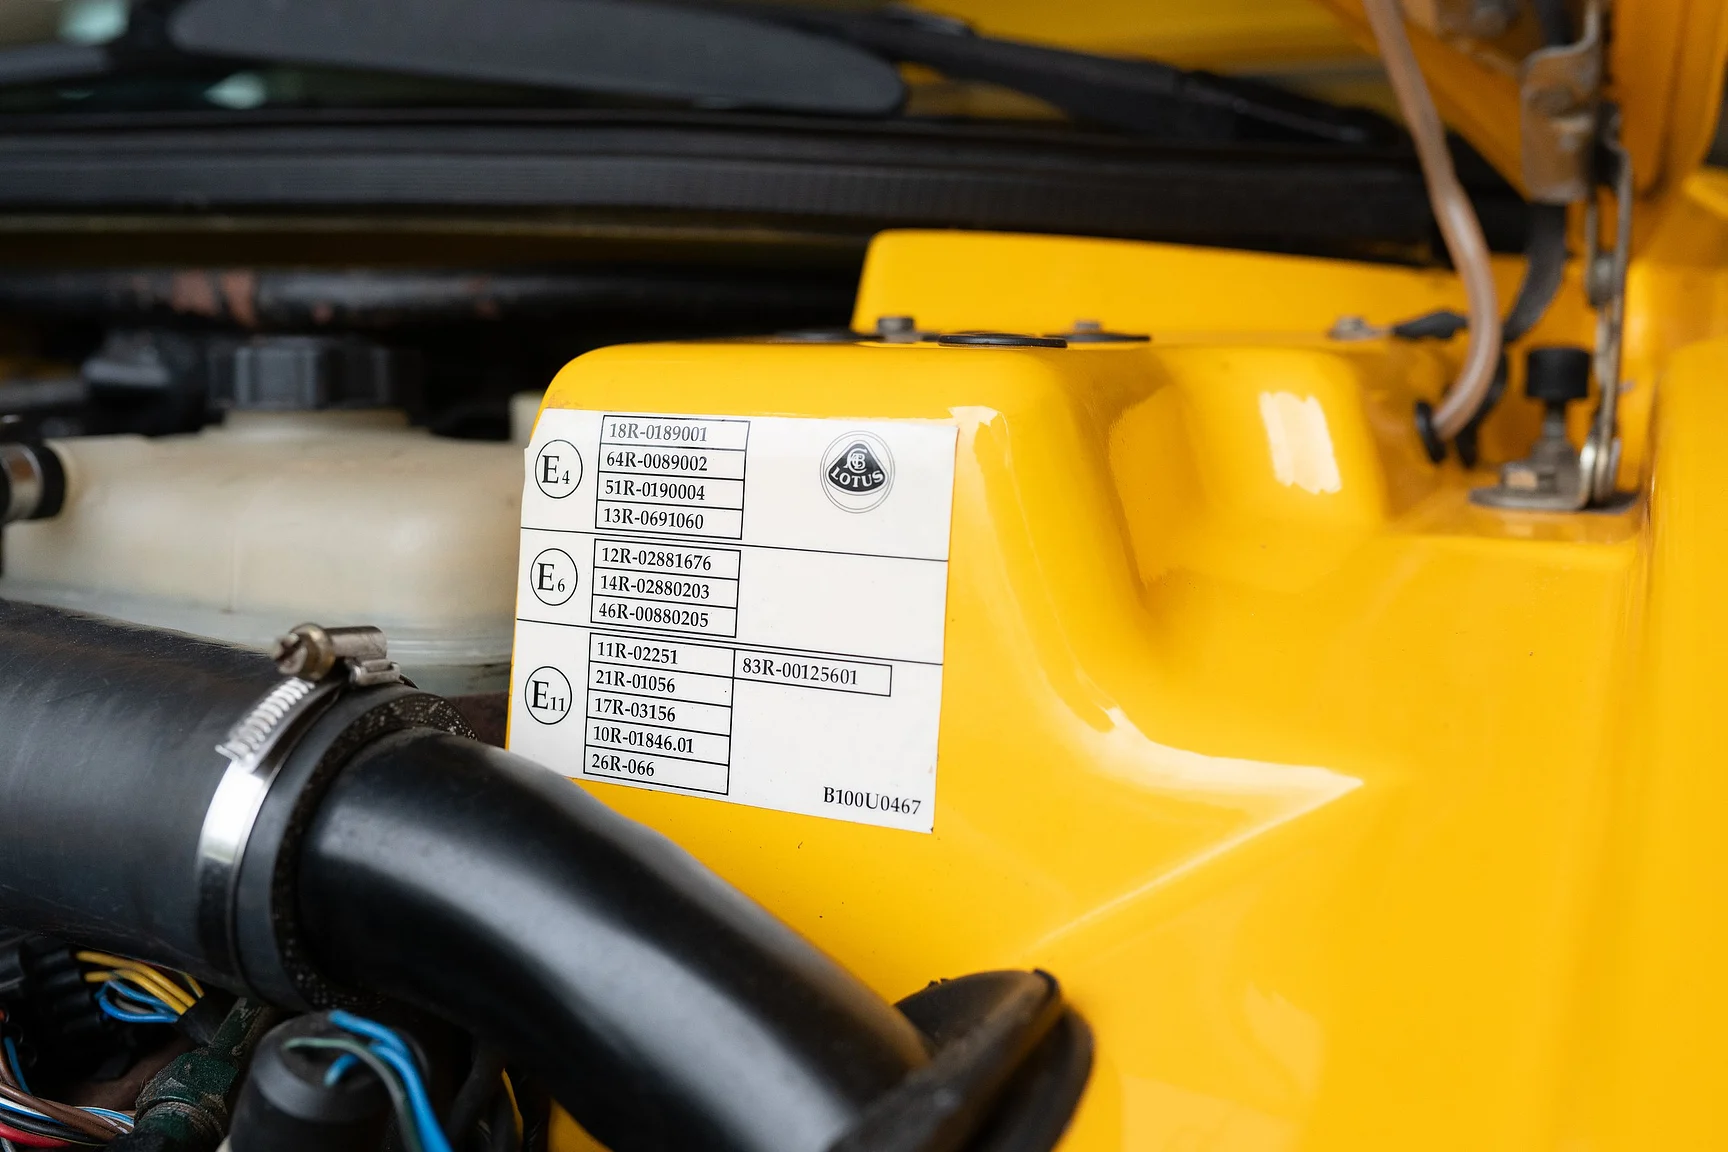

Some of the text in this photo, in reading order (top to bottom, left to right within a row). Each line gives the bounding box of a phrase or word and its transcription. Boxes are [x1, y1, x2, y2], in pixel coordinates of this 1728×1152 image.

[609, 422, 707, 442] 18R-0189001
[606, 450, 708, 471] 64R-0089002
[830, 466, 884, 488] LOTUS
[605, 479, 705, 501] 51R-0190004
[603, 508, 704, 530] 13R-0691060
[602, 547, 712, 571] 12R-02881676
[600, 575, 710, 600] 14R-02880203
[598, 602, 709, 628] 46R-00880205
[597, 641, 678, 665] 11R-02251
[596, 669, 676, 693] 21R-01056
[742, 657, 858, 686] 83R-00125601
[594, 697, 676, 722] 17R-03156
[593, 725, 694, 754] 10R-01846.01
[591, 753, 655, 777] 26R-066
[823, 786, 922, 815] B100U0467
